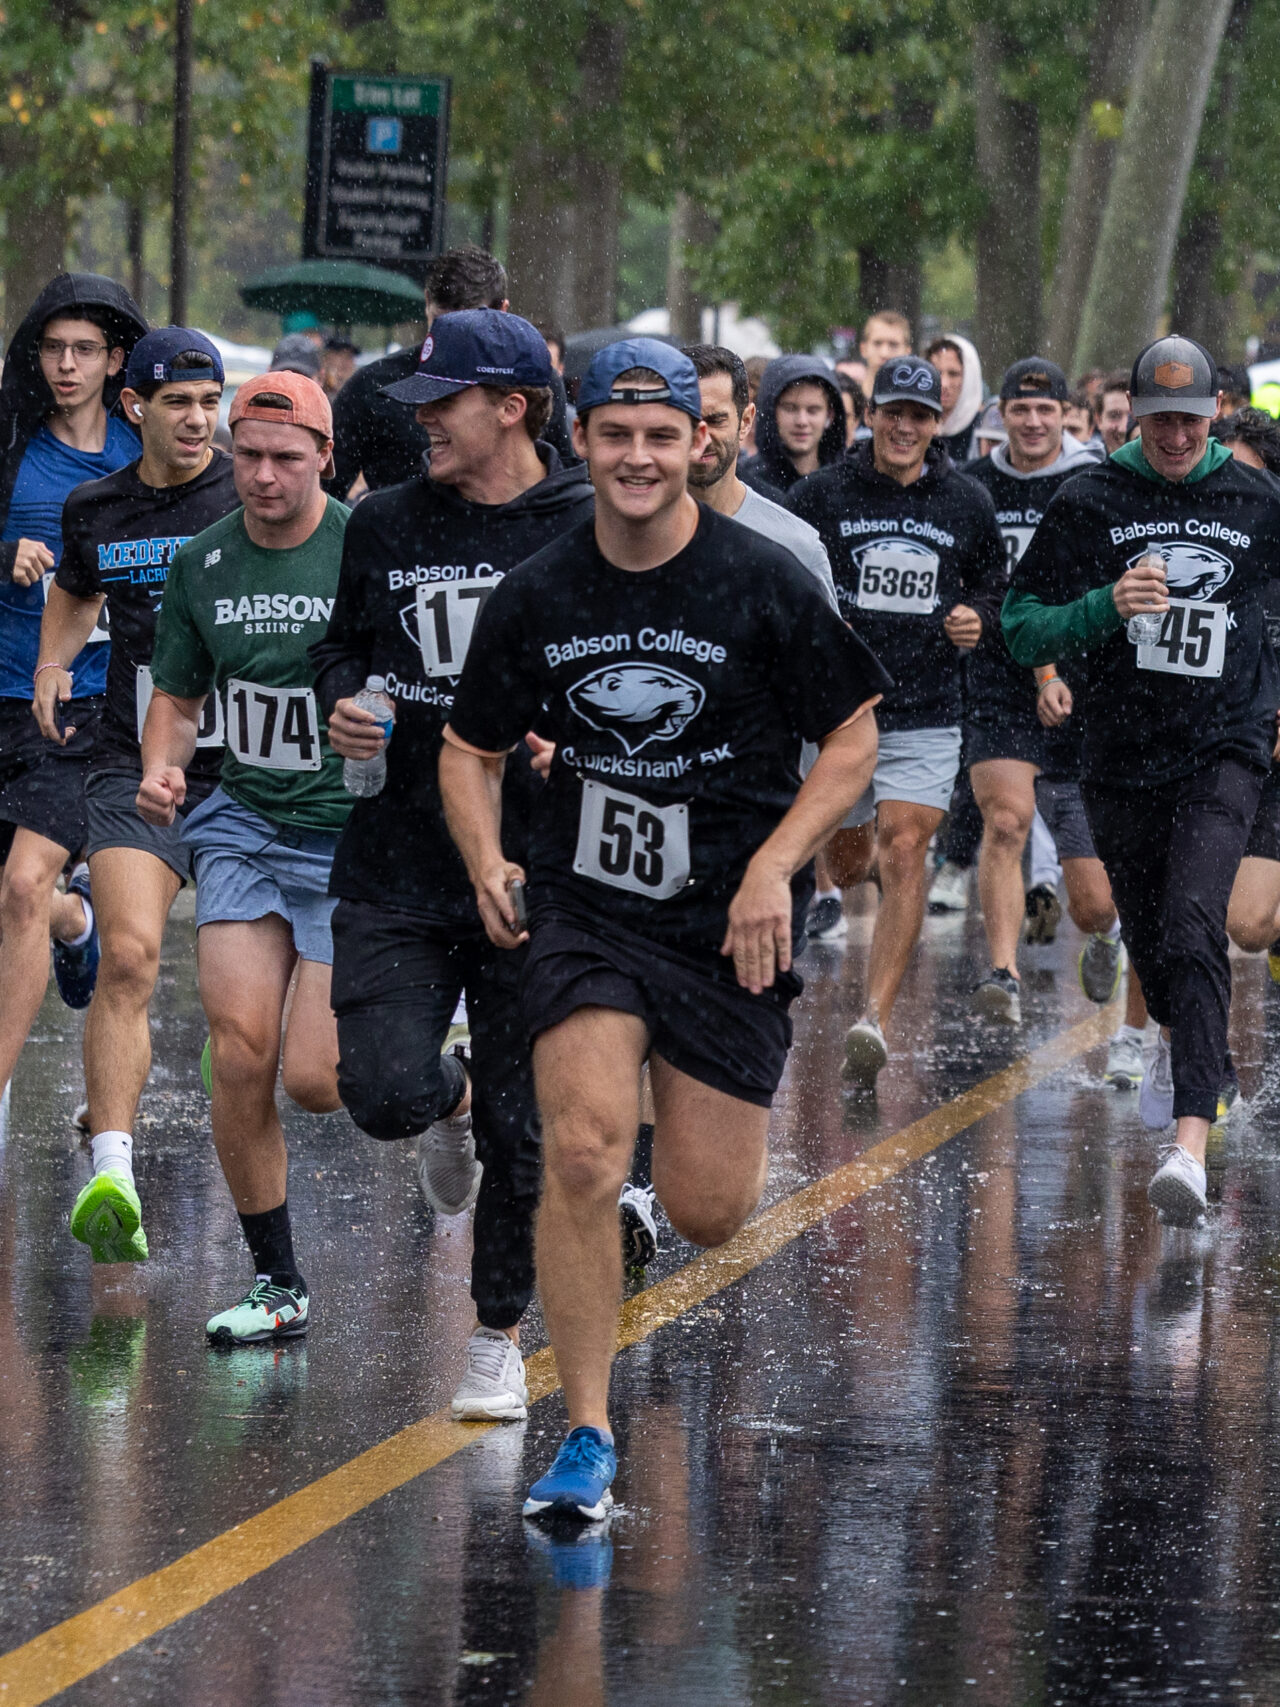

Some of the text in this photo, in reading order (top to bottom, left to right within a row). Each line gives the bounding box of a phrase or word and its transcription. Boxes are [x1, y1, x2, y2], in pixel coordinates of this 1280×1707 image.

[840, 518, 955, 547] Babson College
[1110, 519, 1251, 549] Babson College
[97, 536, 196, 570] MEDFI
[388, 564, 468, 591] Babson
[862, 564, 934, 599] 5363
[214, 593, 336, 625] BABSON
[244, 622, 301, 634] SKIING
[1155, 605, 1215, 668] 45
[544, 627, 728, 668] Babson College
[384, 672, 455, 707] Cruicks
[233, 688, 316, 761] 174
[562, 742, 736, 778] Cruickshank 5K
[598, 796, 665, 888] 53
